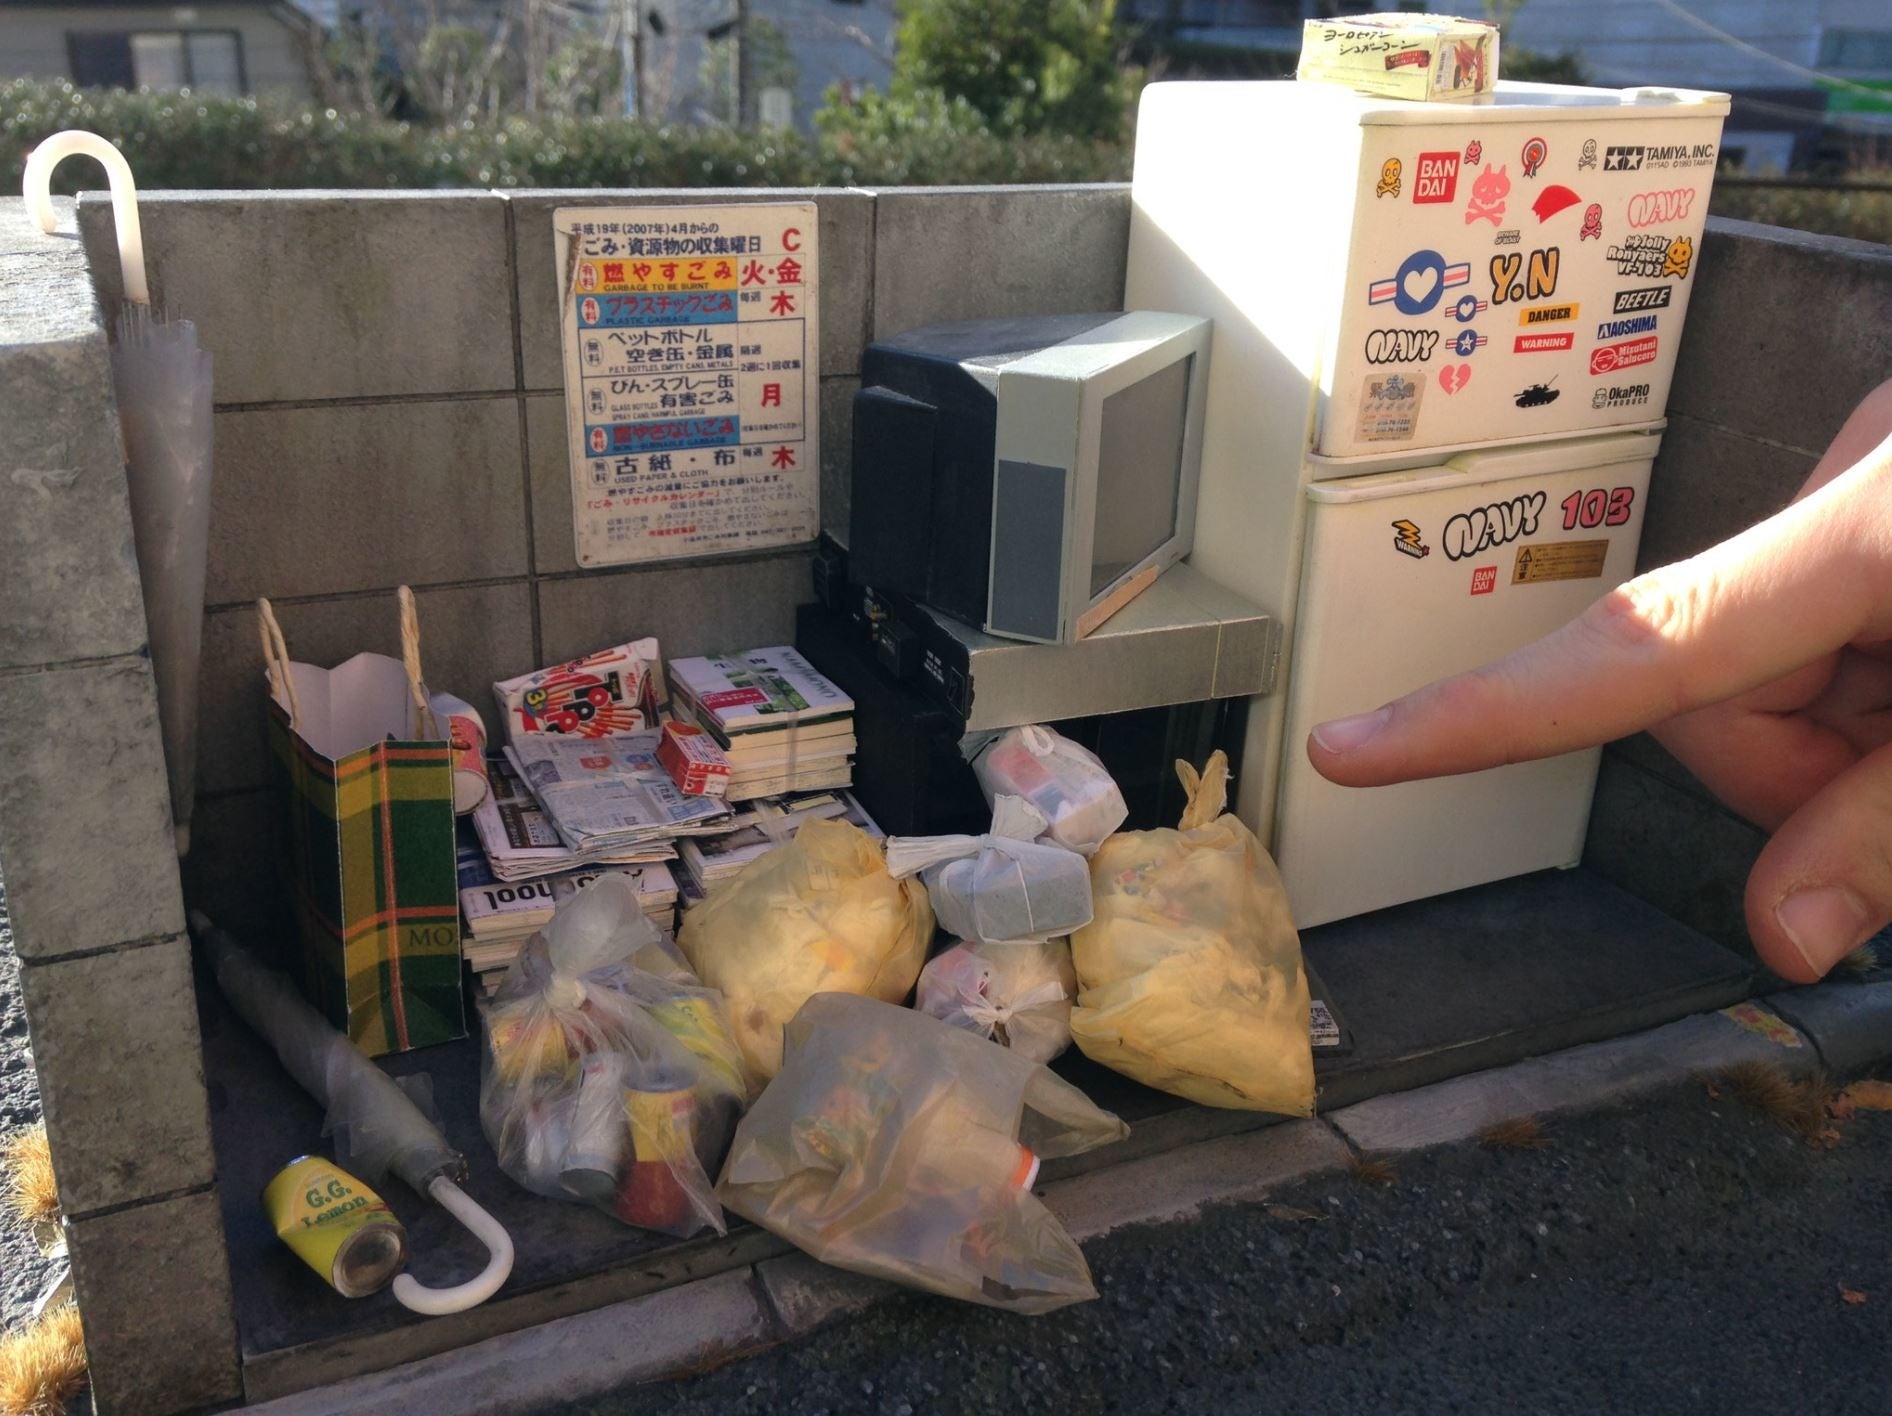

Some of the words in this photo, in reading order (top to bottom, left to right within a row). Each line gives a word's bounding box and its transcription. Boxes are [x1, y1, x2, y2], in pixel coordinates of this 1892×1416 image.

[1421, 159, 1457, 178] BAN
[1418, 180, 1446, 197] DAI
[1627, 188, 1696, 228] NAVY
[584, 235, 761, 256] ごみ・資源物の収集曜日
[782, 228, 801, 252] C
[603, 260, 733, 283] 燃やすごみ
[741, 257, 802, 286] 火・金
[1618, 262, 1662, 277] VF-103
[604, 283, 647, 292] GARBAGE
[652, 283, 664, 291] TO
[667, 282, 678, 290] BE
[681, 281, 709, 290] BURNT
[605, 293, 734, 316] プラスチックごみ
[769, 290, 795, 317] 木
[1614, 288, 1669, 310] BEETLE
[1528, 307, 1571, 323] DANGER
[1610, 315, 1657, 337] AOSHIMA
[626, 343, 734, 364] 空き缶・金属
[1365, 329, 1439, 365] NAVY
[1521, 337, 1567, 349] WARNING
[610, 373, 735, 395] びん・スプレー缶
[1609, 383, 1650, 400] OkaPRO
[660, 390, 735, 408] 有害ごみ
[761, 383, 781, 408] 月
[615, 449, 736, 475] 古紙・布
[772, 446, 796, 470] 木
[640, 473, 668, 481] PAPER
[680, 470, 709, 478] CLOTH
[1442, 490, 1547, 561] NAVY
[1561, 486, 1635, 530] 103
[1473, 581, 1489, 592] DAI
[1475, 570, 1495, 581] BAN
[409, 927, 458, 947] MO
[306, 1179, 352, 1208] G.G.
[301, 1196, 367, 1228] Lemon
